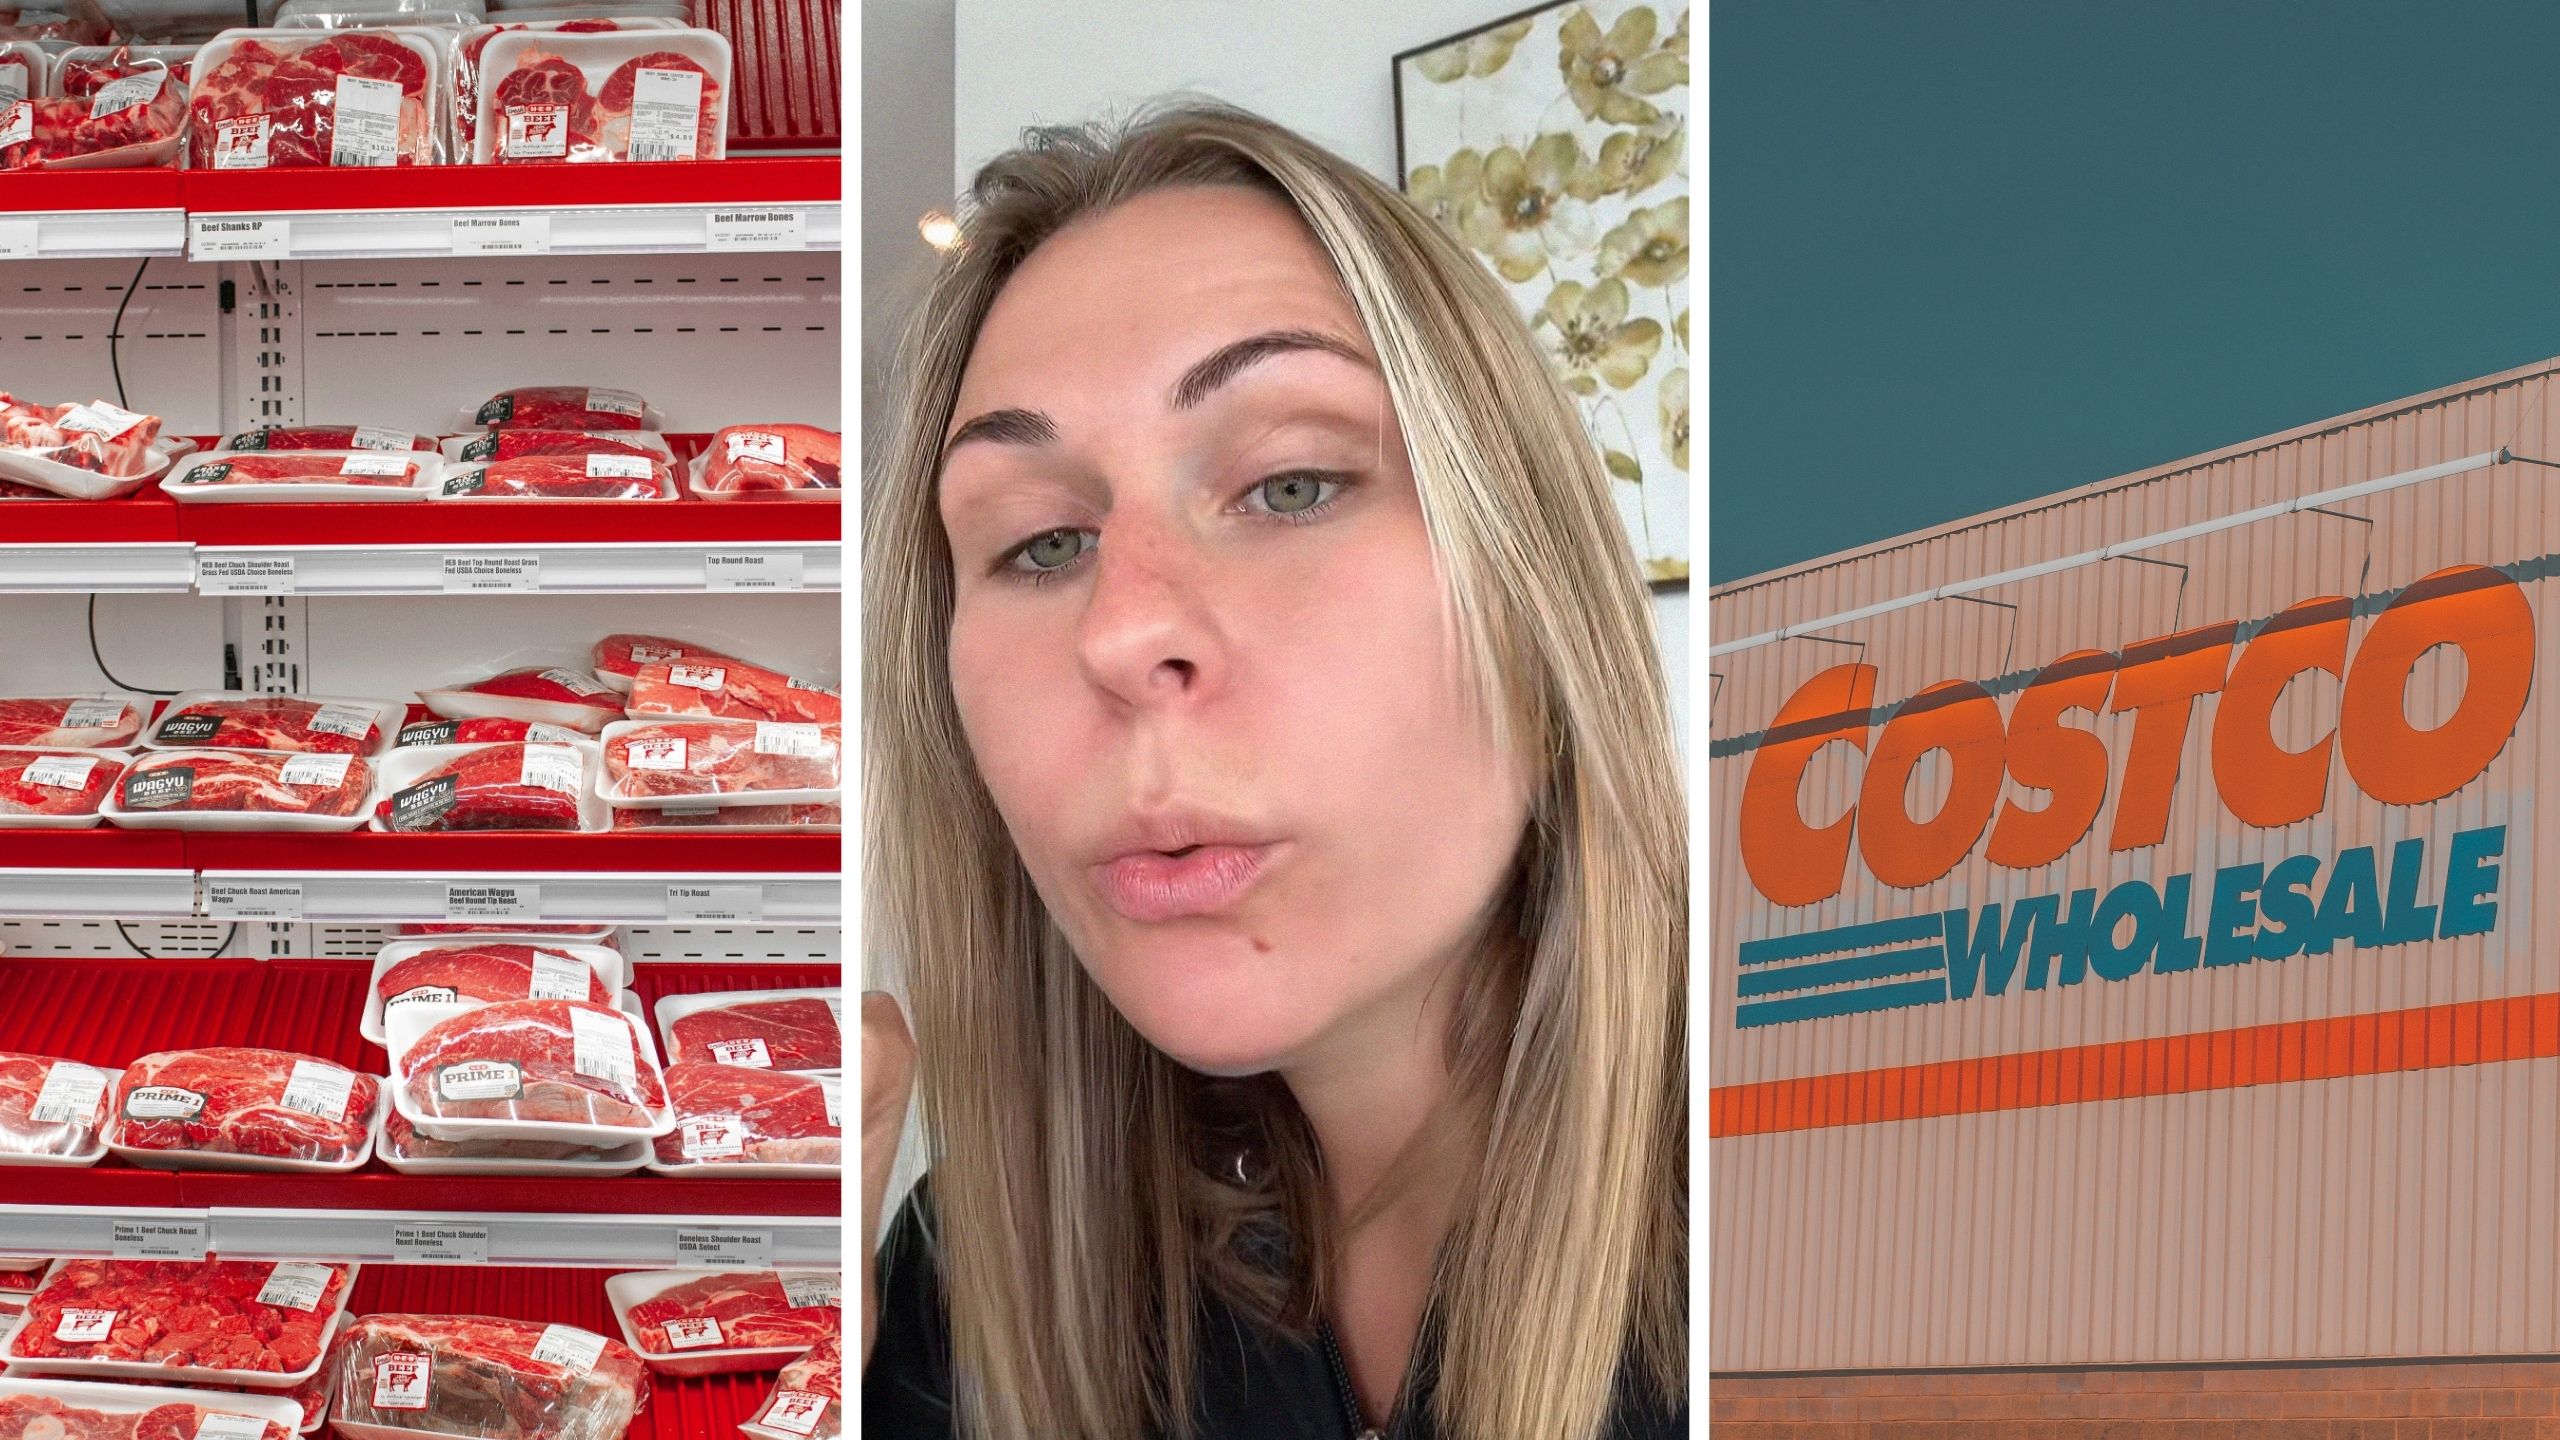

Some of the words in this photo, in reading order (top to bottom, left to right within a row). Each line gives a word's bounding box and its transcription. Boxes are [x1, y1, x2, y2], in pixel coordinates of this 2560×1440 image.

[231, 126, 260, 134] BEEF
[715, 214, 733, 222] Beef
[735, 213, 767, 222] Marrow
[768, 213, 794, 221] Bones
[201, 223, 219, 232] Beef
[221, 222, 250, 231] Shanks
[252, 222, 263, 230] RP
[454, 219, 469, 227] Beef
[471, 219, 497, 227] Marrow
[473, 559, 482, 567] Top
[708, 557, 720, 565] Top
[165, 723, 213, 733] WAGYU
[402, 727, 449, 742] WAGYU
[1740, 564, 2536, 908] COSTCO
[133, 776, 184, 793] WAGYU
[144, 788, 171, 796] BEEF
[401, 782, 448, 808] WAGYU
[411, 796, 436, 810] BEEF
[449, 888, 487, 896] American
[488, 888, 515, 897] Wagyu
[680, 889, 690, 897] Tip
[1943, 825, 2506, 999] WHOLESALE
[445, 1070, 504, 1083] PRIME
[509, 1070, 515, 1079] 1
[134, 1093, 191, 1103] PRIME
[141, 1226, 156, 1234] Beef
[179, 1227, 197, 1235] Roast
[421, 1230, 435, 1238] Beef
[458, 1231, 486, 1239] Shoulder
[396, 1238, 413, 1246] Roast
[679, 1234, 709, 1242] Boneless
[710, 1234, 741, 1243] Shoulder
[742, 1236, 761, 1244] Roast
[698, 1243, 720, 1251] Select
[388, 1364, 419, 1372] BEEF
